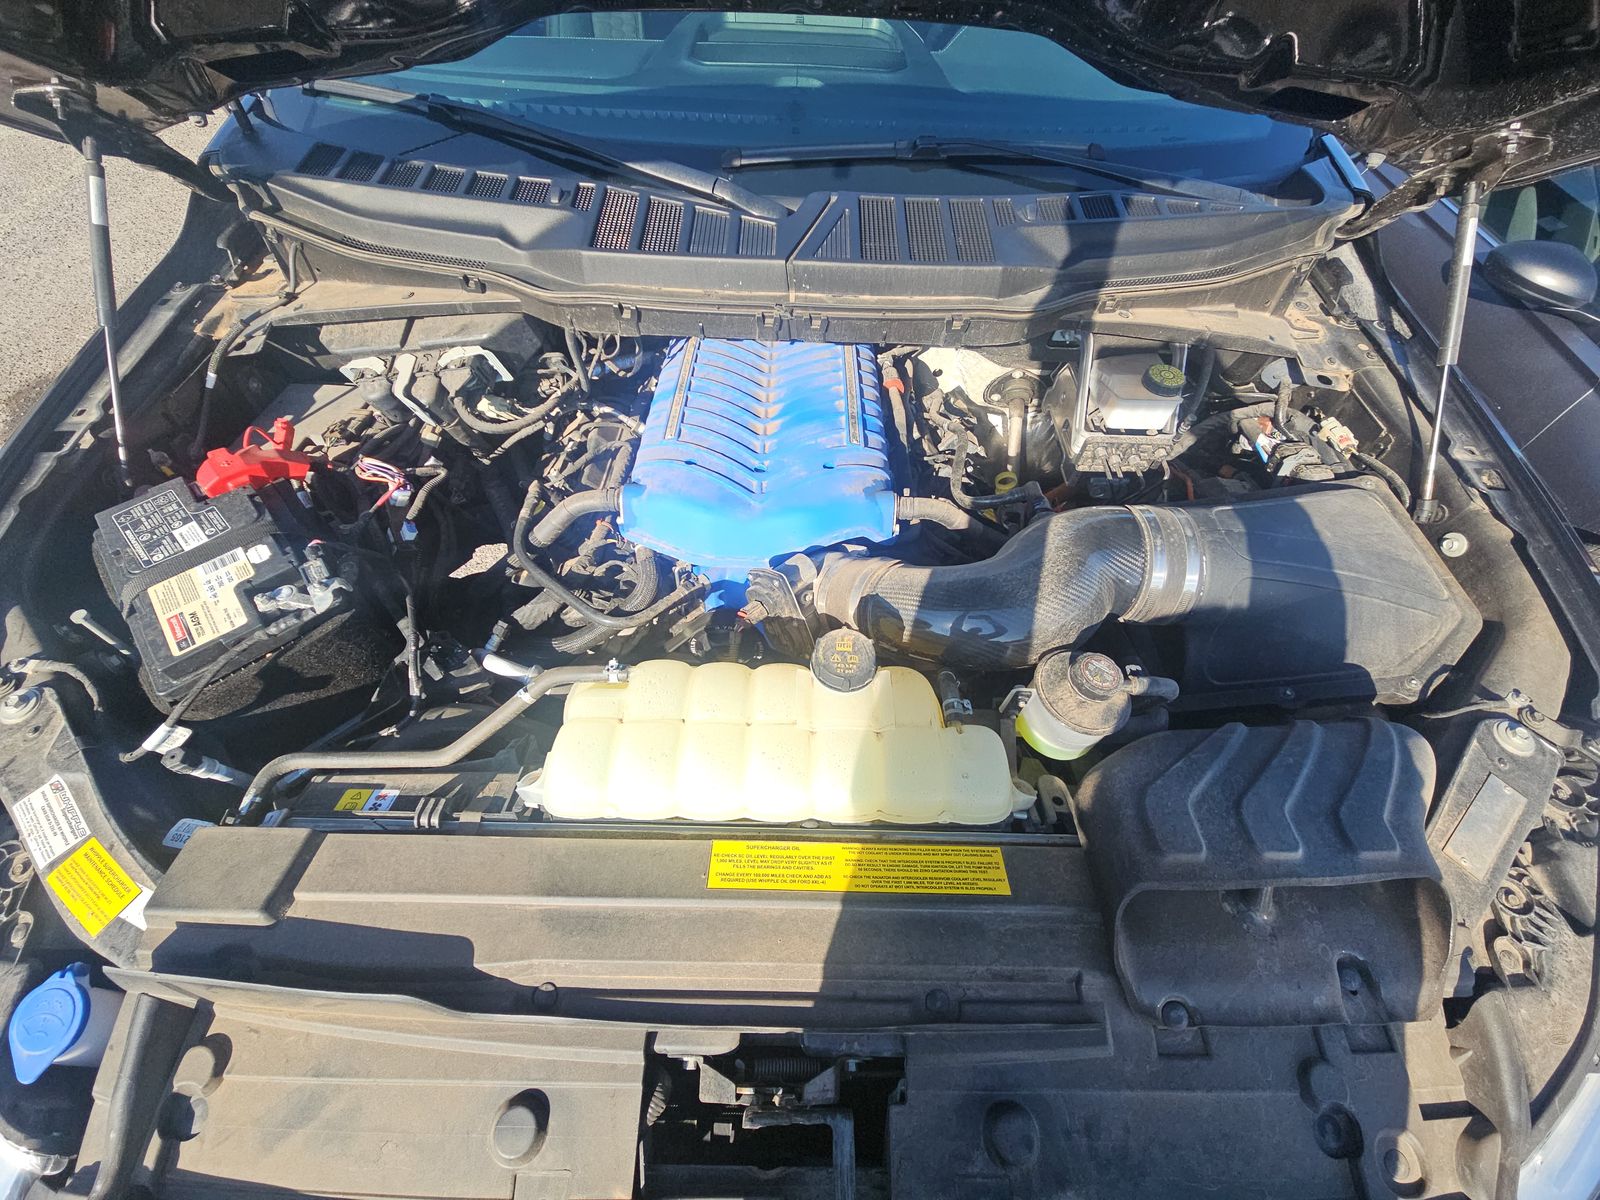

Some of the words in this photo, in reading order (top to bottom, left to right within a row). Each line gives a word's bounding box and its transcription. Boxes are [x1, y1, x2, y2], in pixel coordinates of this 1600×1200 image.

[188, 610, 201, 626] AGM
[82, 852, 107, 879] MAINTENANCE
[104, 877, 124, 899] SCHEDULE
[88, 846, 105, 864] WHIPPLE
[102, 861, 131, 894] SUPERCHARGER
